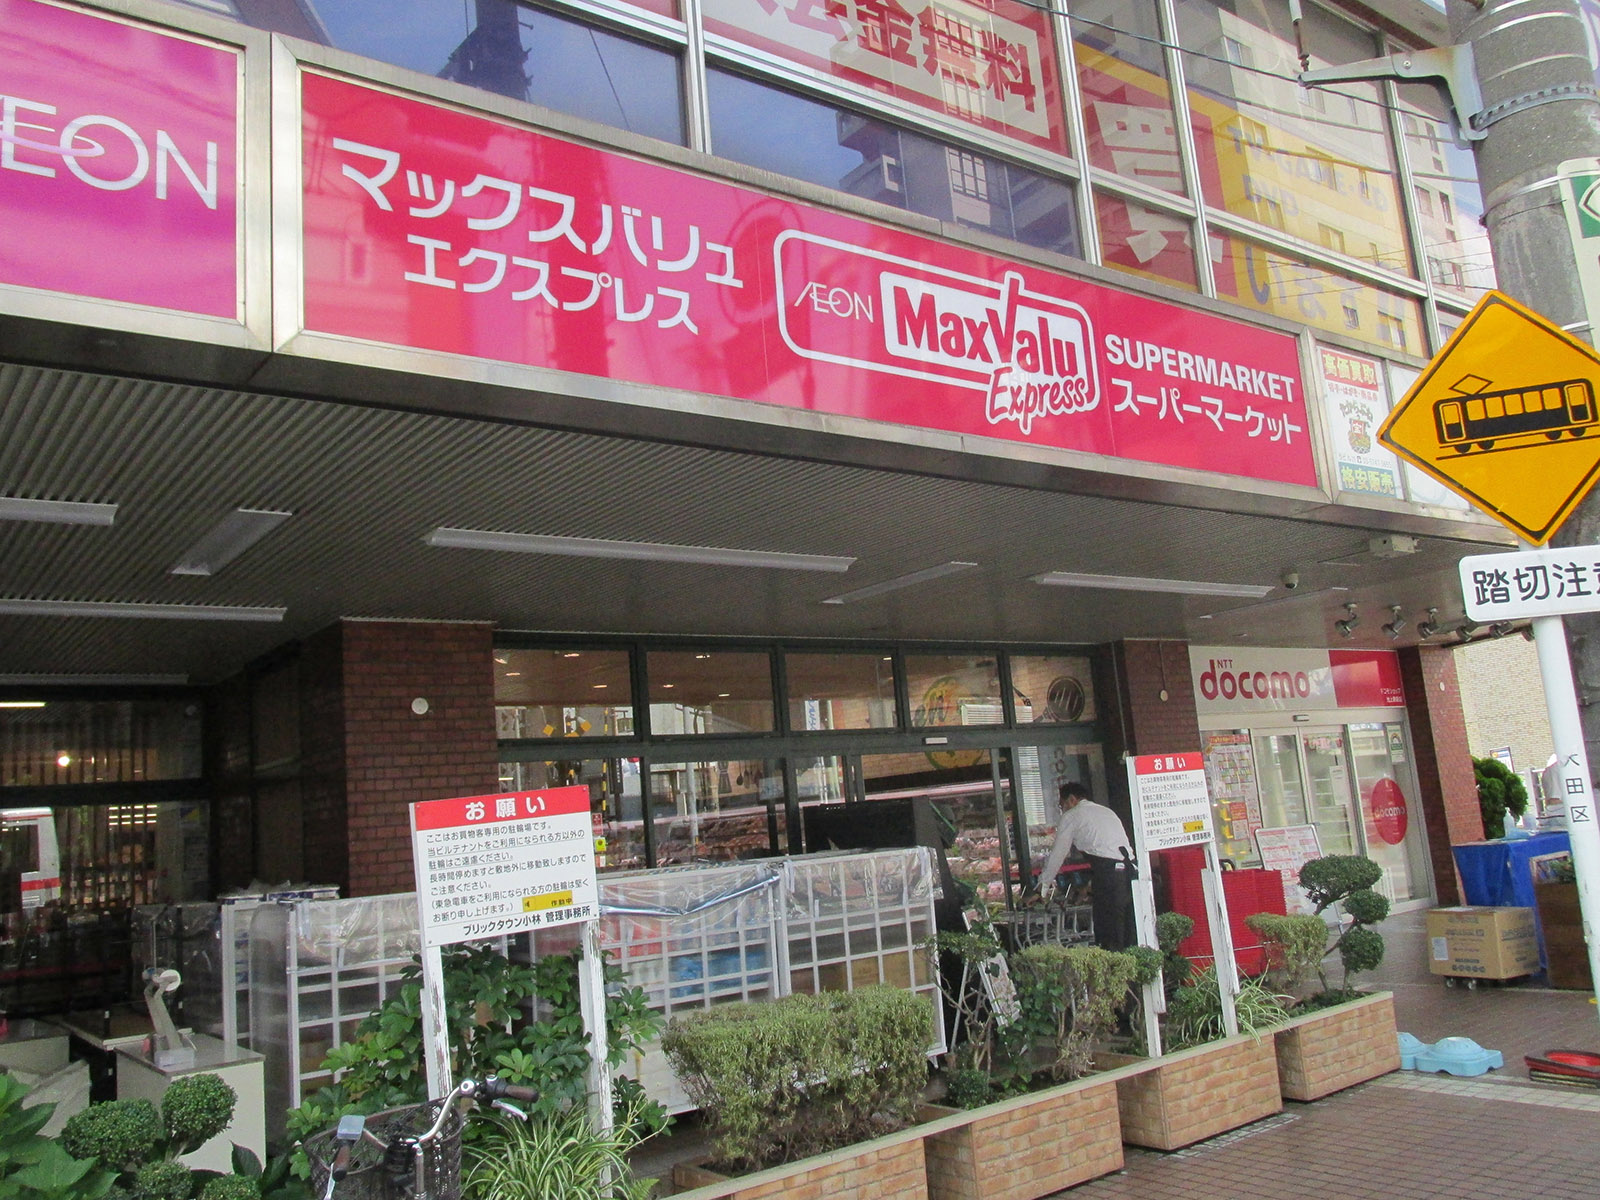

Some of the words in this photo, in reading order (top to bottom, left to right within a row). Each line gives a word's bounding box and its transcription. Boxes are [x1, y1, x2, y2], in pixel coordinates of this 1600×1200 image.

[0, 94, 218, 210] EON
[332, 136, 744, 289] マックスバリュ
[404, 233, 699, 336] エクスプレス
[893, 277, 1079, 379] MaxValu
[1104, 333, 1295, 403] SUPERMARKET
[1323, 353, 1377, 386] 高価買取
[988, 366, 1089, 431] Express
[1111, 377, 1302, 445] スーパーマーケット
[1341, 463, 1395, 495] 格安販売
[1200, 659, 1311, 700] docomo
[1217, 659, 1233, 669] NTT
[1153, 757, 1187, 771] お願い
[465, 796, 546, 821] お願い
[463, 913, 542, 936] ブリックタウン小林
[545, 905, 592, 923] 管理事務所
